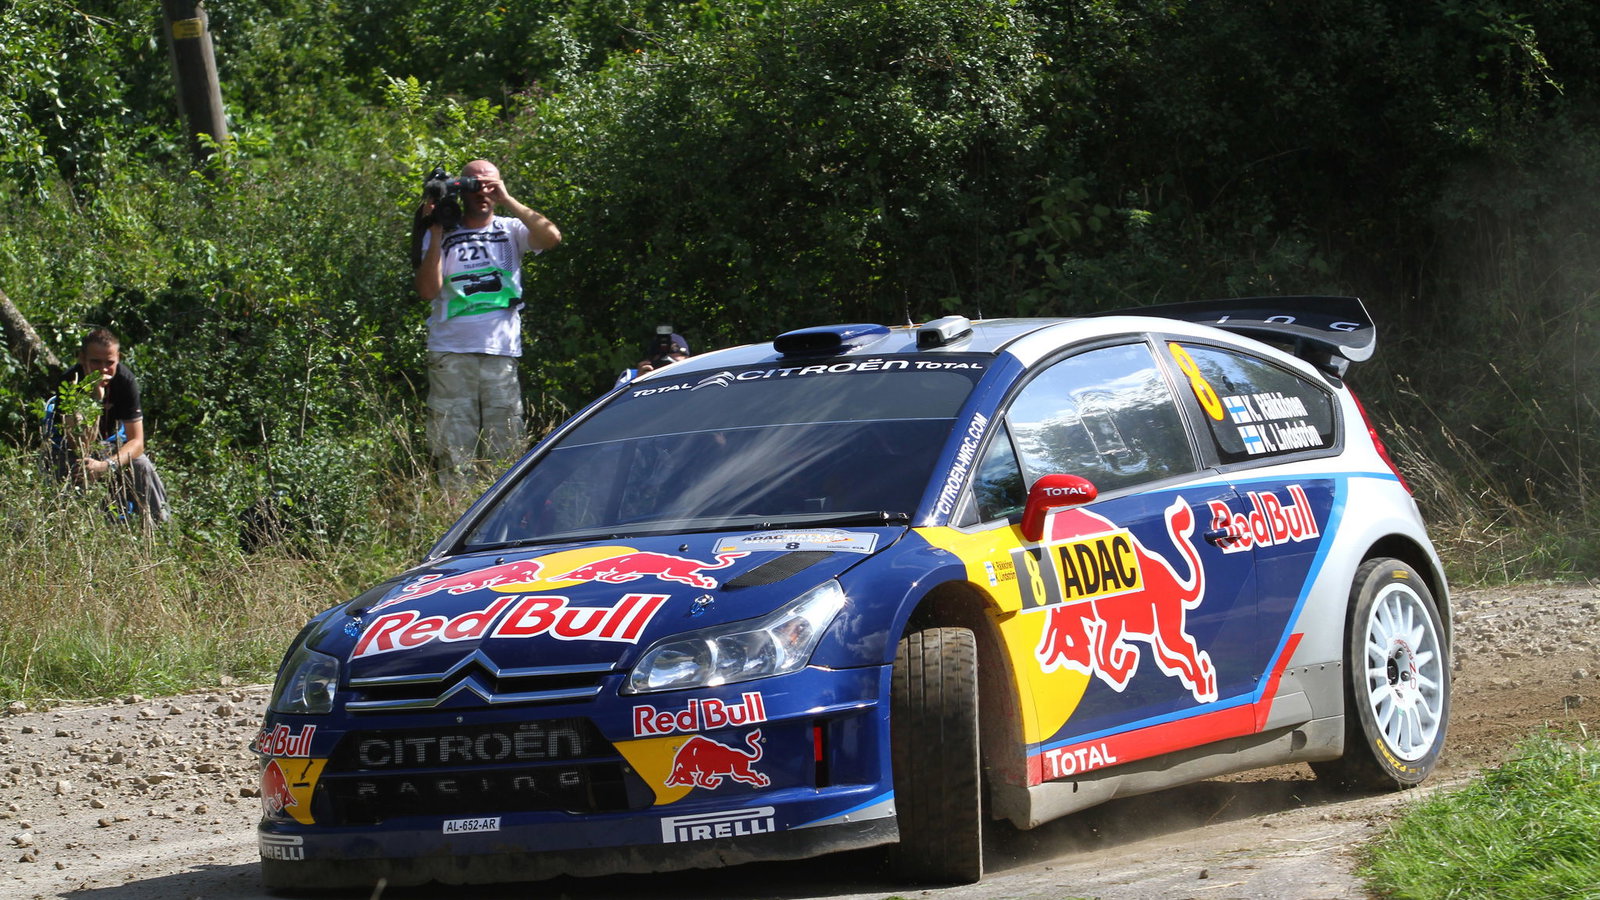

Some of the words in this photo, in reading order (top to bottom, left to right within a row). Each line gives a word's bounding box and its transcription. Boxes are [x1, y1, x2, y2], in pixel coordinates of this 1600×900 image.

[458, 246, 488, 262] 221
[1217, 315, 1361, 332] ING
[633, 383, 692, 398] TOTAL
[736, 358, 909, 381] CITROËN
[915, 361, 983, 370] TOTAL
[1168, 342, 1225, 421] 8
[936, 411, 989, 515] CITROEN-WRC.COM
[1043, 487, 1087, 496] TOTAL
[1207, 491, 1274, 554] Red
[1258, 484, 1320, 545] Bull
[785, 541, 801, 550] 8
[1023, 550, 1046, 606] 8
[1060, 537, 1136, 598] ADAC
[348, 594, 515, 663] Red
[490, 594, 671, 644] Bull
[633, 699, 698, 737] Red
[701, 691, 768, 731] Bull
[272, 725, 317, 757] Bull
[358, 723, 582, 766] CITROËN
[1046, 743, 1117, 777] TOTAL
[358, 771, 579, 795] RACING
[447, 819, 496, 832] AL-652-AR
[660, 806, 776, 844] PIRELLI
